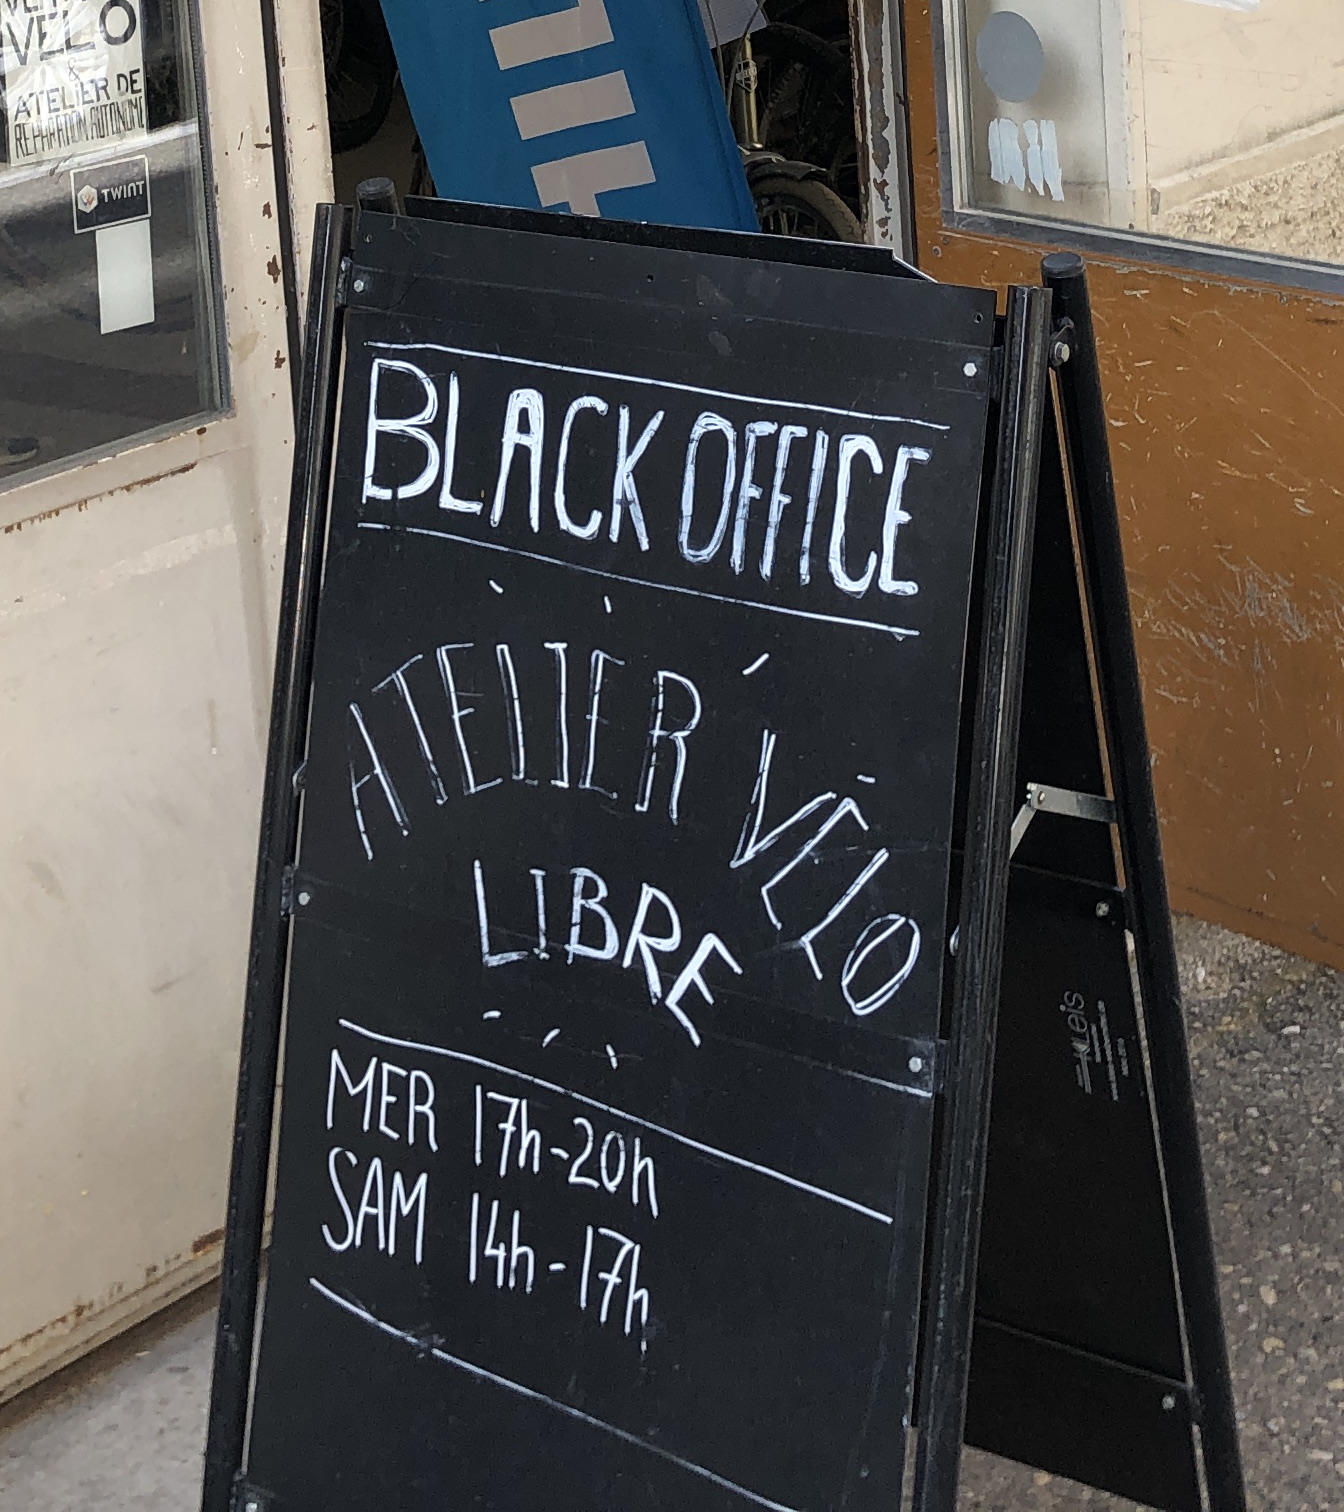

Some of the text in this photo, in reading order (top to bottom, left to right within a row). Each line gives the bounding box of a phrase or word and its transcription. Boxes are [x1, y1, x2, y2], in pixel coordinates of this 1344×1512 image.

[14, 68, 142, 122] ATELIER DE
[361, 358, 932, 597] BLACK OFFICE
[349, 642, 922, 1016] ATELIER VÉLO
[471, 858, 744, 1047] LIBRE
[324, 1048, 439, 1153] MER
[321, 1147, 429, 1265] SAM
